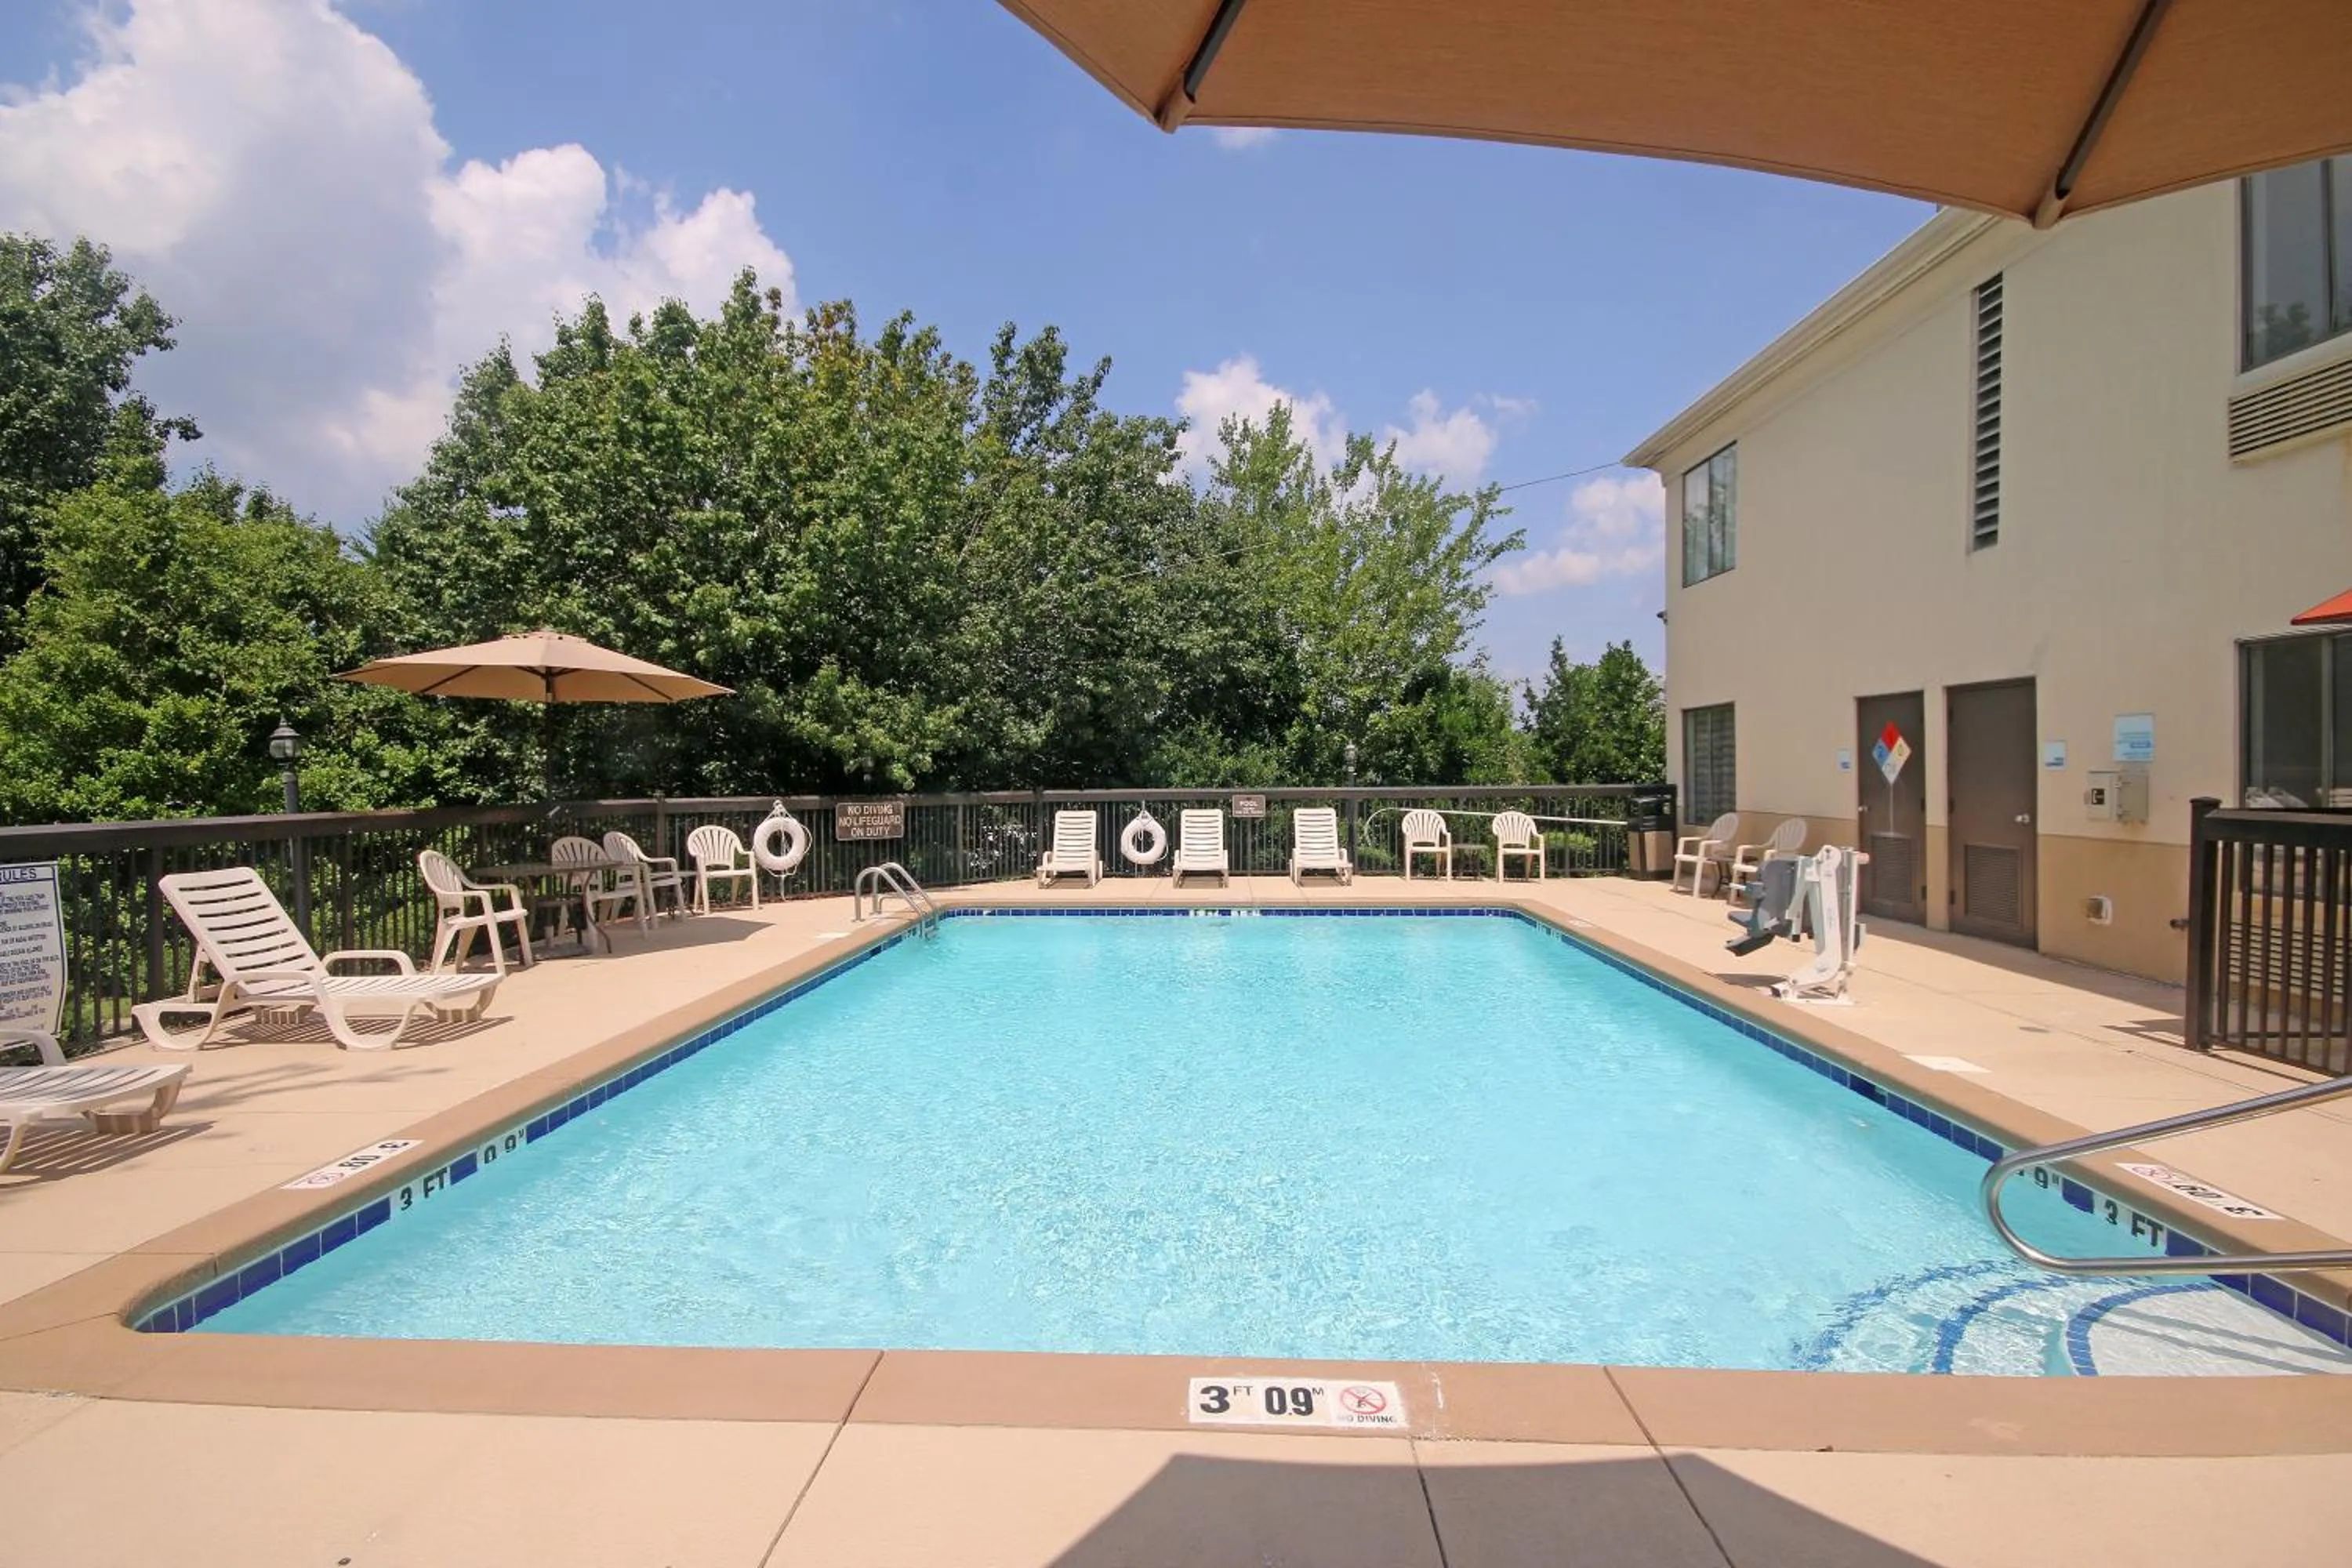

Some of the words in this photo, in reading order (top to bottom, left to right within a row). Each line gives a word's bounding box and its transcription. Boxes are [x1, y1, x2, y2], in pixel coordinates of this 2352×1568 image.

[848, 806, 862, 815] NO
[863, 804, 894, 815] DIVING
[838, 817, 852, 827] NO
[853, 815, 901, 826] LIFEGUARD
[851, 827, 863, 837] ON
[866, 826, 890, 837] DUTY
[0, 868, 37, 883] ULES
[400, 1187, 412, 1210] 3
[423, 1167, 448, 1198] FT
[2104, 1200, 2118, 1225] 3
[2132, 1211, 2164, 1247] FT
[1200, 1385, 1230, 1414] 3
[1233, 1385, 1254, 1396] FT
[1312, 1387, 1325, 1396] M
